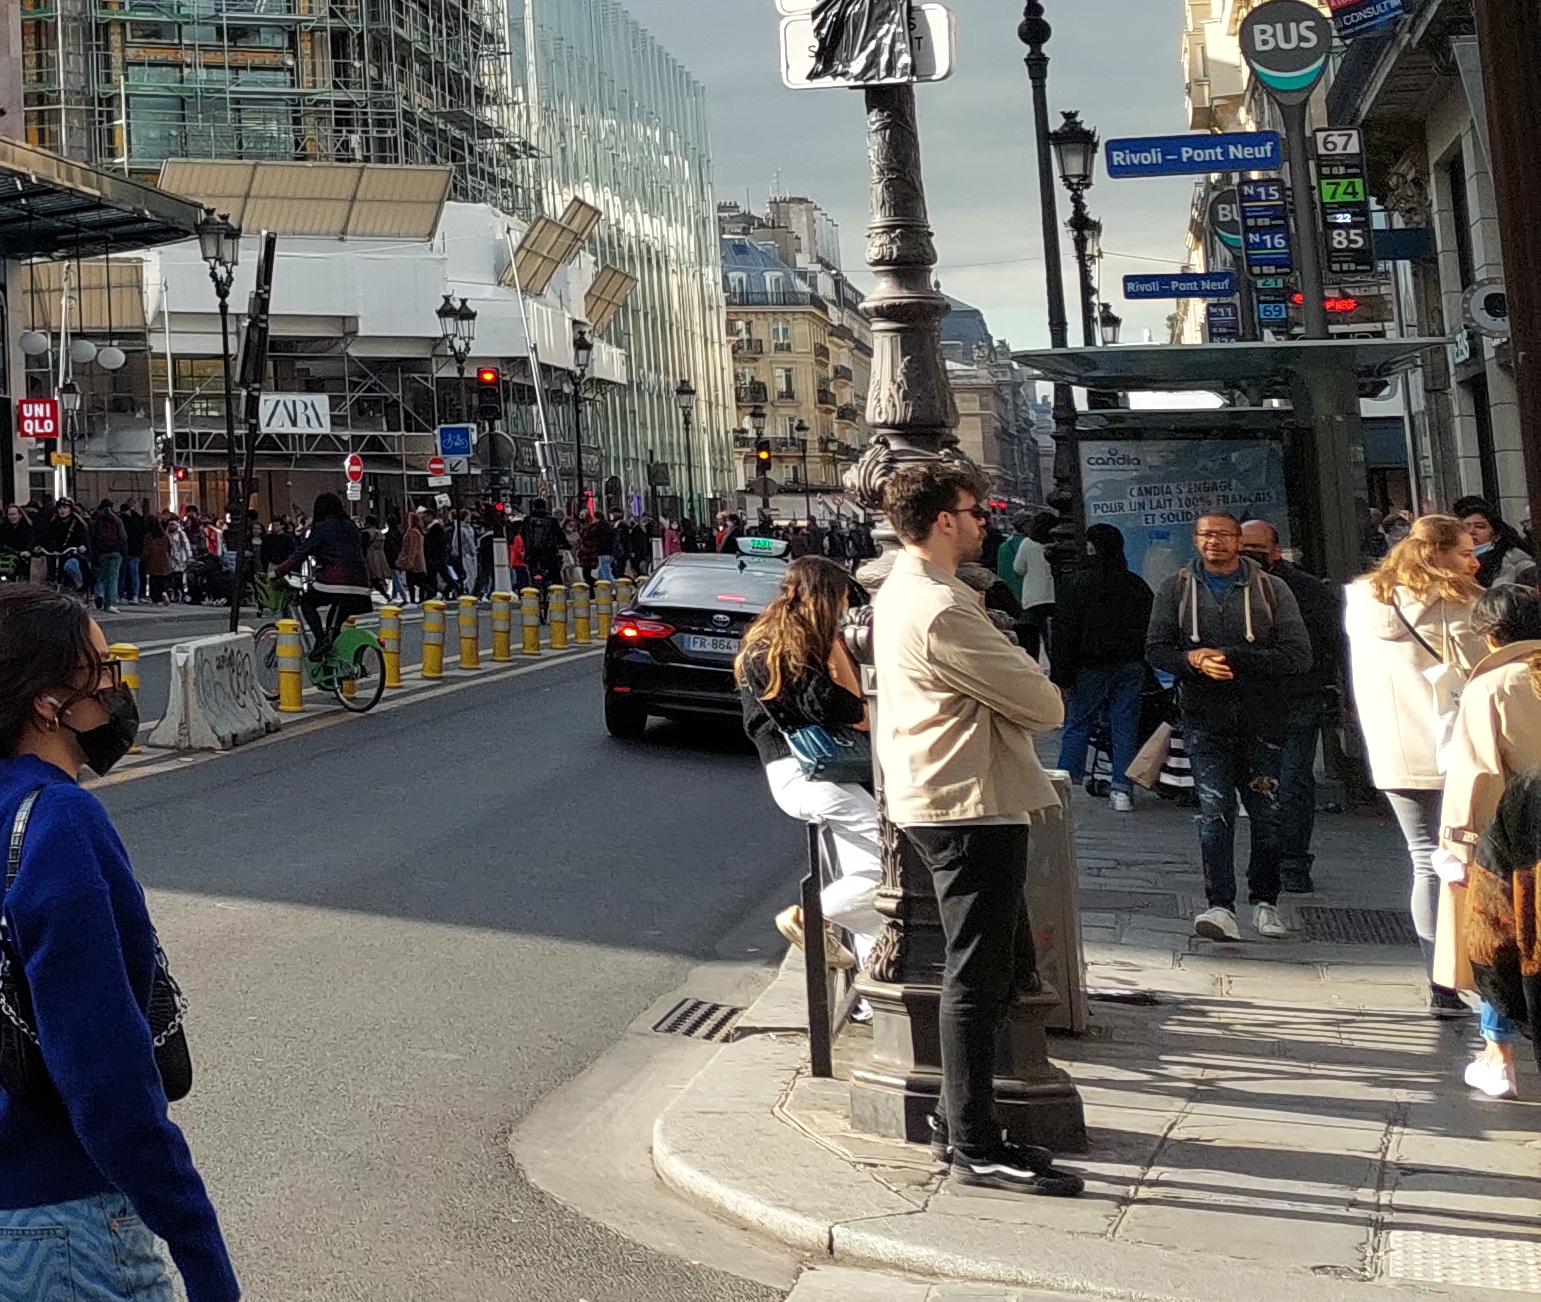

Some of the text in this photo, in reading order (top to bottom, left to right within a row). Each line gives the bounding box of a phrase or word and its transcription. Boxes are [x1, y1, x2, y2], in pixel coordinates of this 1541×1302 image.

[1253, 20, 1318, 52] BUS
[1322, 133, 1353, 152] 67
[1111, 148, 1162, 166] Rivoli
[1181, 145, 1224, 162] Pont
[1229, 141, 1274, 160] Neuf
[1325, 181, 1359, 199] 74
[1332, 229, 1364, 248] 85
[1126, 281, 1159, 292] Rivoli
[1171, 281, 1198, 291] Pont
[1201, 279, 1229, 290] Neuf
[1262, 305, 1282, 317] 69
[22, 403, 51, 417] UNI
[263, 398, 325, 429] ZARA
[23, 419, 54, 435] QLO
[1087, 453, 1141, 467] candia
[1129, 484, 1173, 498] CANDIA
[1093, 501, 1125, 514] POUR
[1129, 500, 1146, 512] UN
[1149, 498, 1173, 511] LAIT
[1176, 496, 1213, 509] 100%
[1144, 513, 1156, 525] ET
